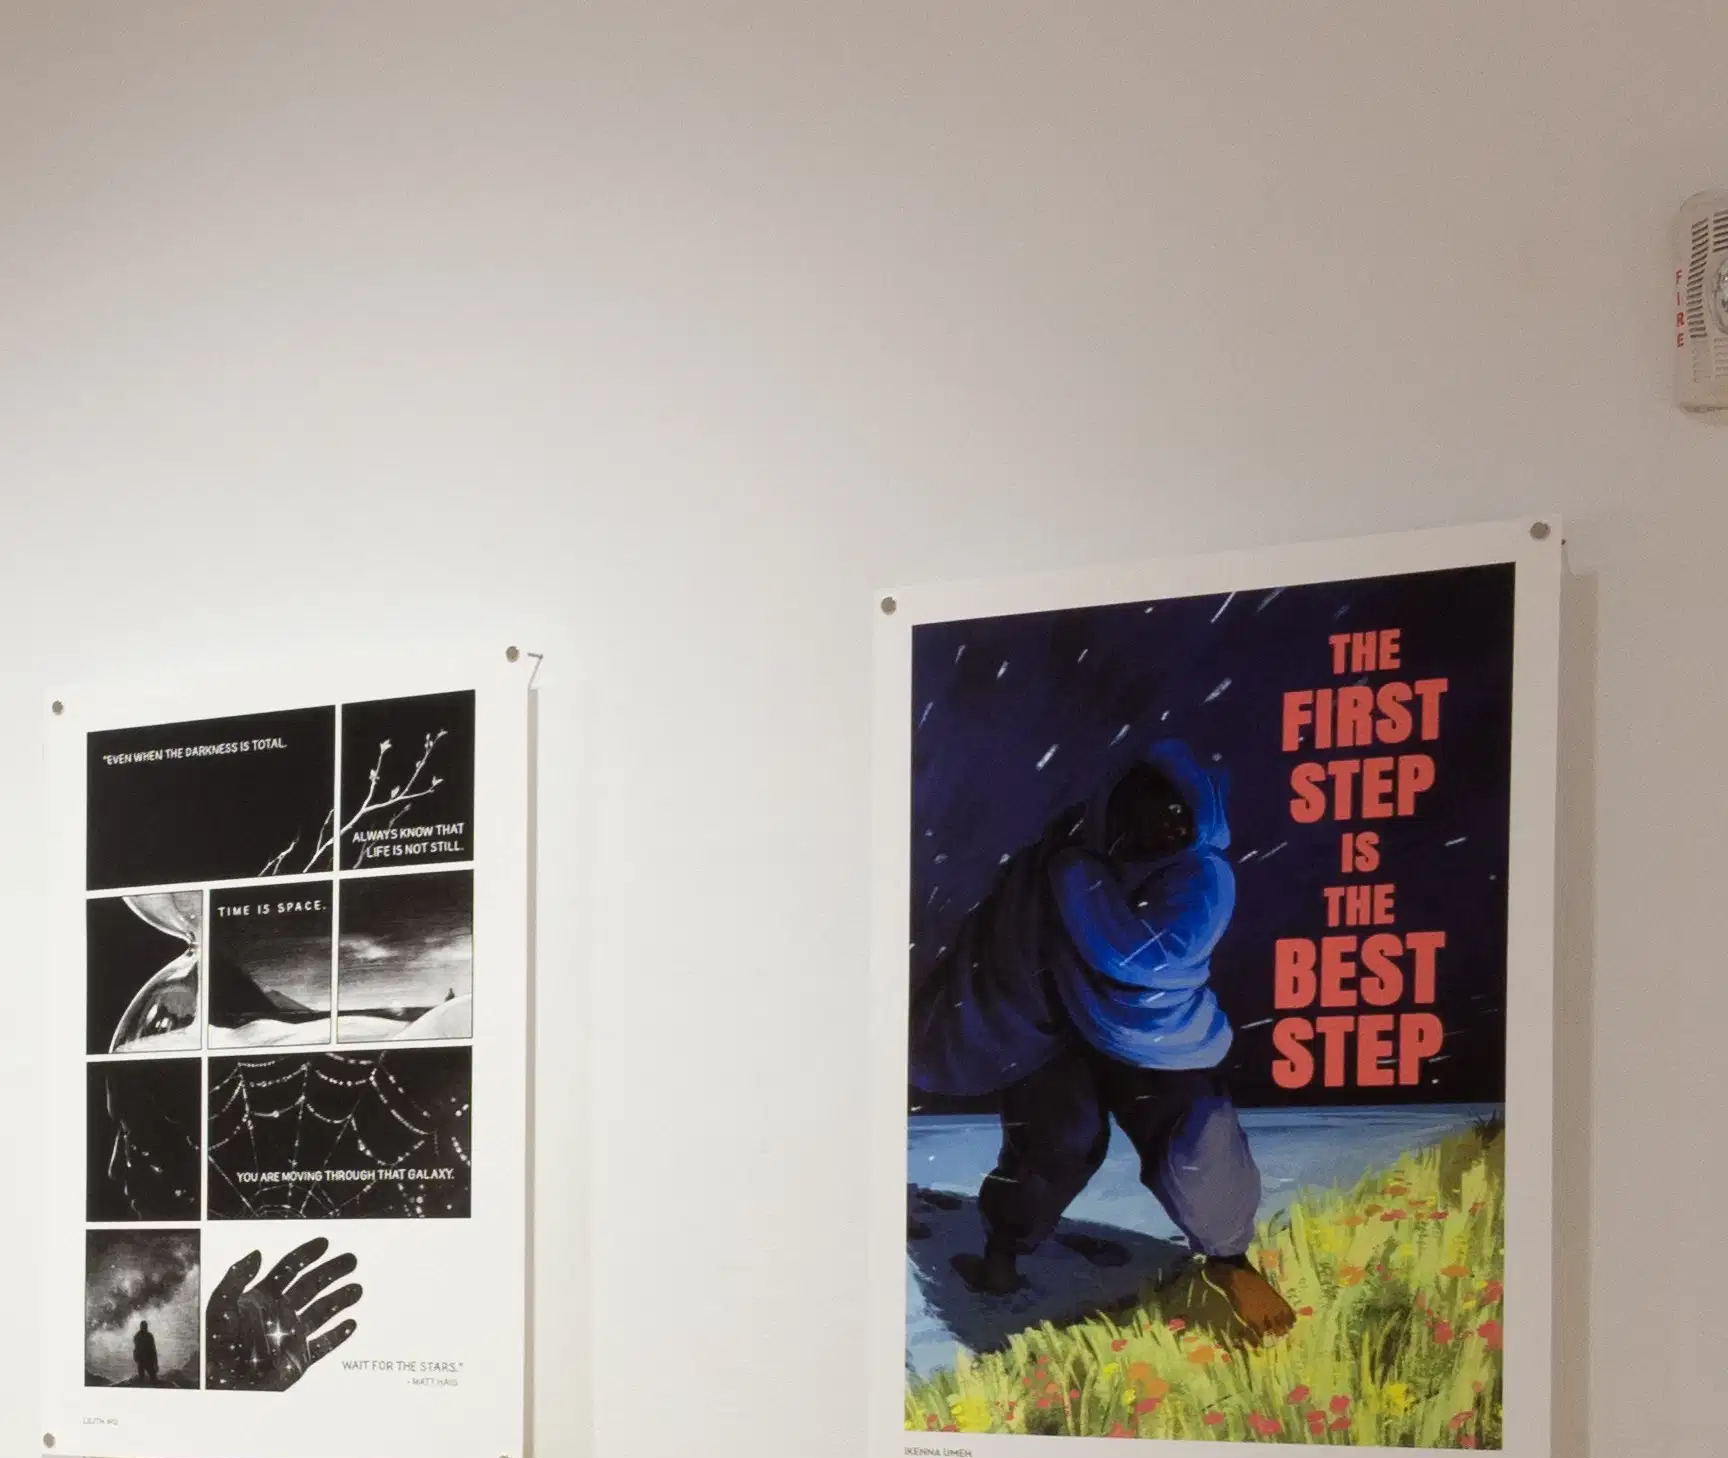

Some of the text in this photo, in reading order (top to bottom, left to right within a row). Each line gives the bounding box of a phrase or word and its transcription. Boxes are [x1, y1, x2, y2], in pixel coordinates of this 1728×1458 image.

[1675, 269, 1685, 348] FIRE
[1329, 628, 1401, 674] THE
[1282, 678, 1449, 752] FIRST
[134, 750, 163, 763] WHEN
[165, 747, 183, 760] THE
[185, 742, 238, 758] DARKNESS
[240, 740, 250, 753] IS
[1289, 755, 1436, 824] STEP
[352, 822, 465, 843] ALWAYS KNOW THAT
[366, 840, 465, 858] LIFE IS NOT STILL.
[1341, 832, 1380, 873] IS
[217, 900, 327, 917] TIME IS SPACE.
[1323, 884, 1396, 928] THE
[1273, 931, 1447, 1010] BEST
[1271, 1013, 1445, 1090] STEP
[236, 1168, 455, 1182] YOU ARE MOVING THROUGH THAT GALAXY.
[341, 1360, 370, 1372] WAIT
[371, 1360, 393, 1372] FOR
[395, 1360, 417, 1372] THE
